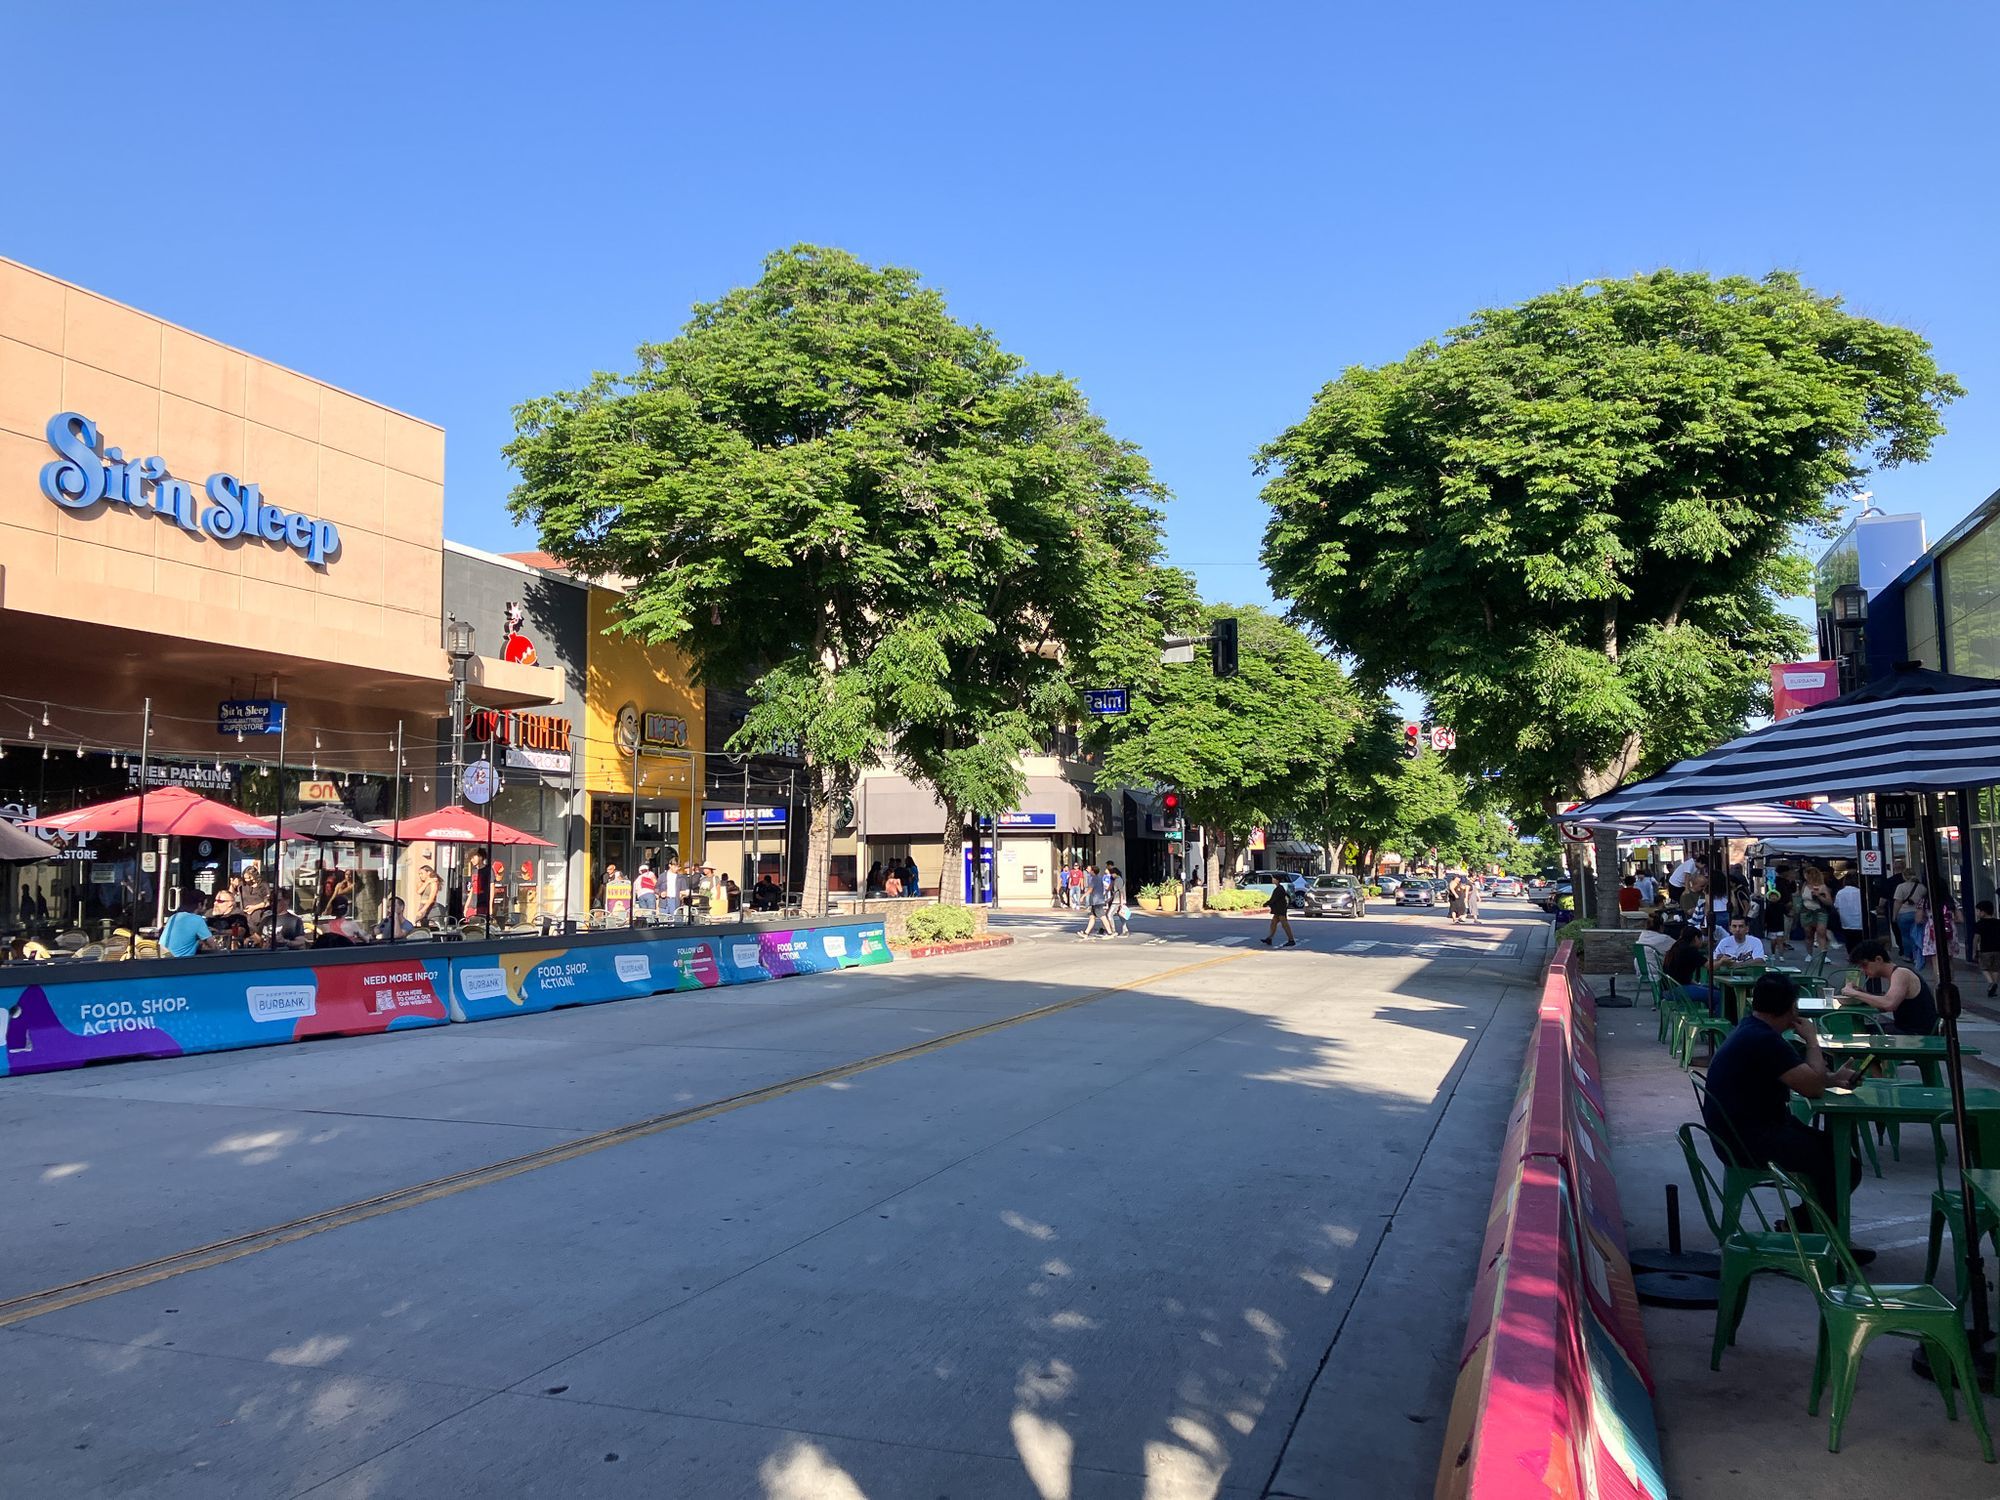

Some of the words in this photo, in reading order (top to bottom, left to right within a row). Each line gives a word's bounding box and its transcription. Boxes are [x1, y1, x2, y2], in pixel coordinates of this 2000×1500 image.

[39, 411, 198, 531] Sit'n
[201, 472, 339, 566] Sleep
[1084, 694, 1122, 709] Palm
[244, 705, 269, 717] Sleep
[1786, 708, 1804, 717] YO
[223, 723, 264, 731] SUPERSTORE
[517, 711, 572, 752] TOMIK
[648, 716, 688, 742] IKE'S
[184, 780, 194, 788] ON
[195, 781, 215, 789] PALM
[1885, 803, 1906, 817] GAP
[677, 947, 696, 955] FOLLOW
[537, 965, 564, 978] FOOD.
[565, 963, 589, 976] SHOP.
[363, 975, 388, 986] NEED
[389, 973, 413, 983] MORE
[414, 971, 438, 981] INFO?
[468, 978, 499, 990] BURBANK
[540, 978, 576, 991] ACTION!
[80, 1001, 137, 1019] FOOD.
[141, 997, 190, 1014] SHOP.
[259, 997, 306, 1011] BURBANK
[83, 1016, 156, 1036] ACTION!
